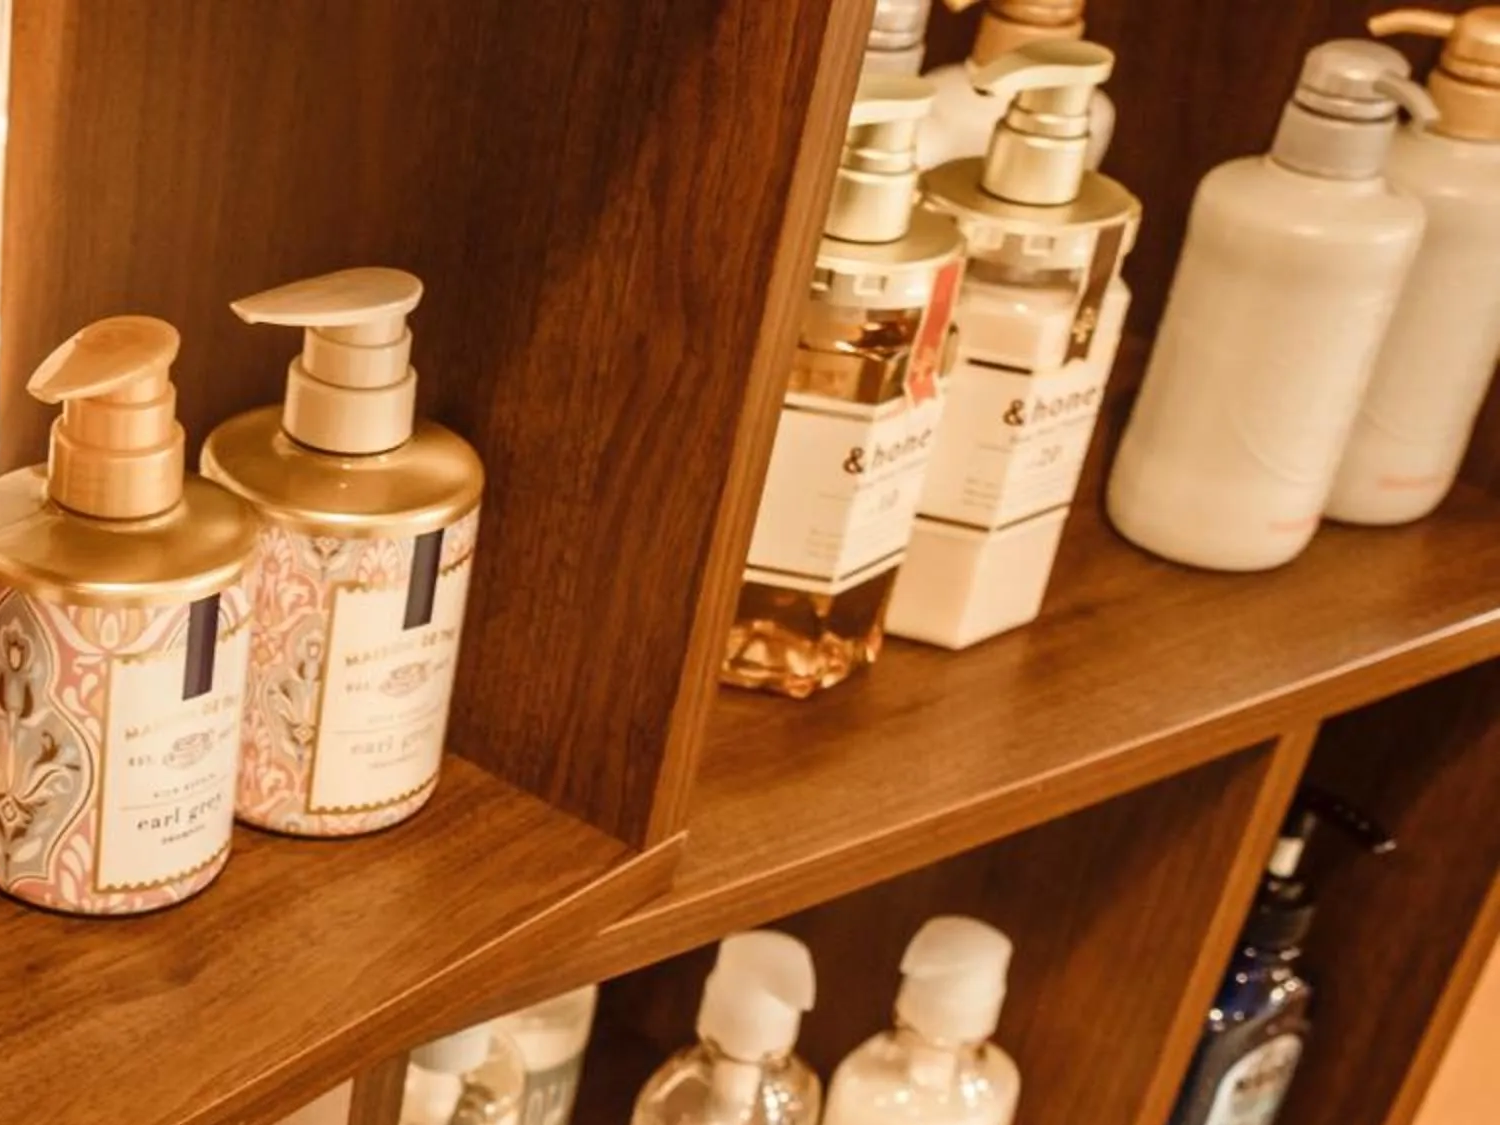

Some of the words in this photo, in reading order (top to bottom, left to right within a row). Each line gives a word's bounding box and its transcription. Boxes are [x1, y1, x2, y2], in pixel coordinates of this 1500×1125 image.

[1003, 399, 1024, 426] &
[842, 446, 864, 474] &
[137, 807, 180, 831] earl
